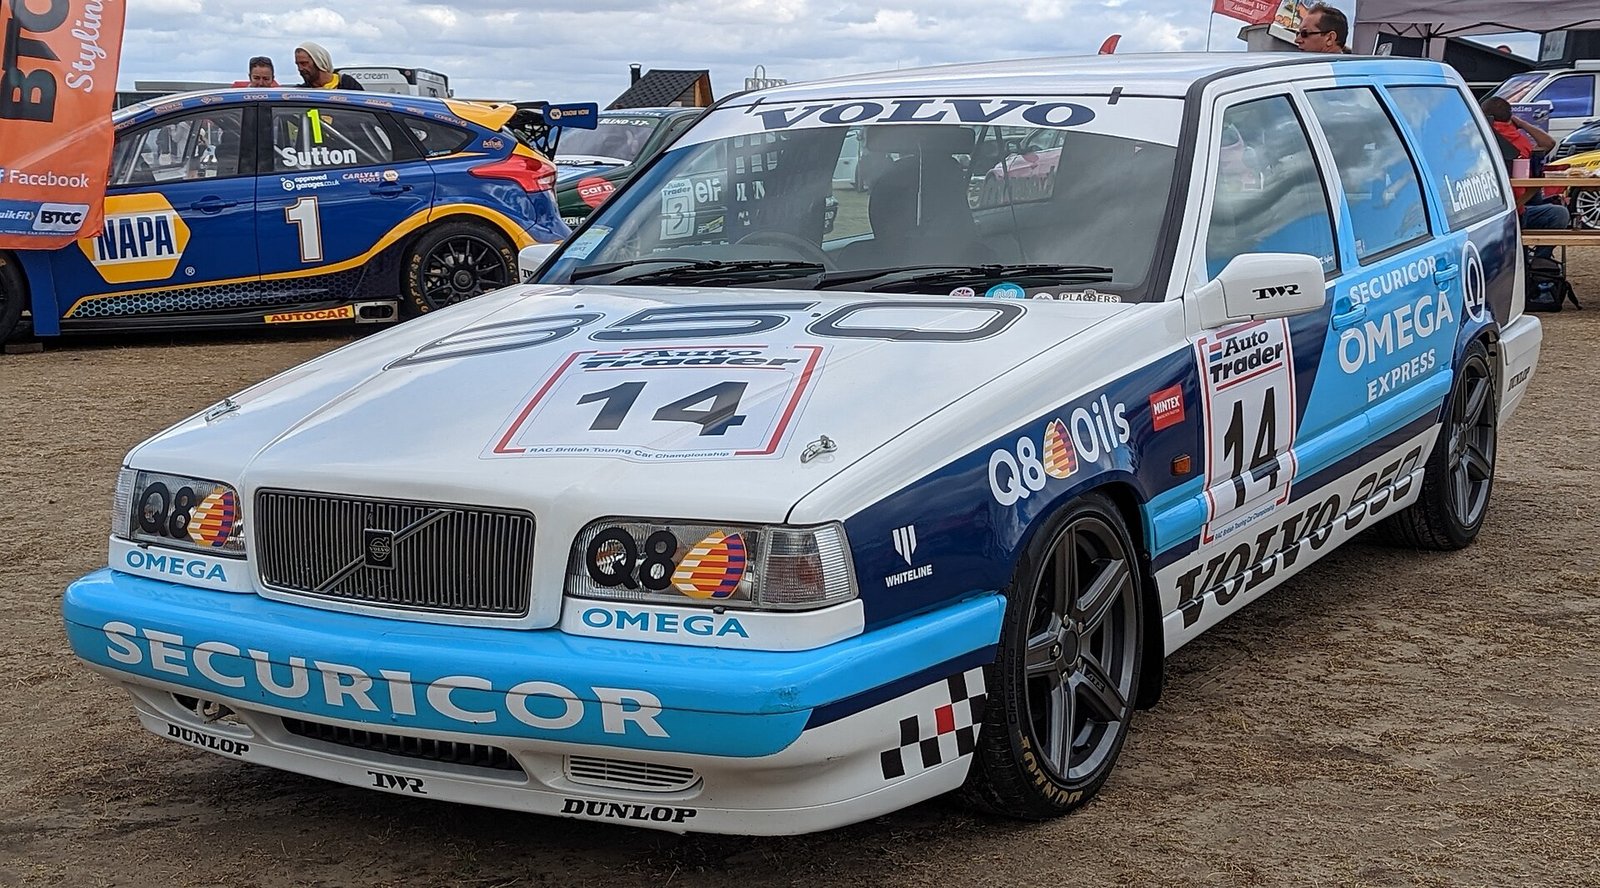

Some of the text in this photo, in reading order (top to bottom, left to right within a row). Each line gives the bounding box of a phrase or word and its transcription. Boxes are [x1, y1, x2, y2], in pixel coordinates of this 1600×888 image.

[65, 0, 113, 93] Stylin
[307, 108, 323, 144] 1
[754, 99, 1096, 131] VOLVO
[282, 146, 358, 167] Sutton
[9, 170, 90, 188] Facebook
[294, 173, 328, 182] approved
[295, 180, 340, 190] garages.co.uk
[342, 171, 380, 180] CARLYLE
[662, 186, 692, 196] Trader
[695, 177, 723, 203] elf
[1444, 172, 1500, 213] Lammers
[41, 210, 82, 225] BTCC
[285, 196, 324, 262] 1
[100, 215, 175, 260] NAPA
[1252, 284, 1302, 300] TWR
[1349, 255, 1437, 306] SECURICOR
[270, 307, 350, 322] AUTOCAR
[381, 301, 1028, 371] 850
[1223, 328, 1269, 358] Auto
[1338, 290, 1454, 374] OMEGA
[578, 356, 802, 370] Trader
[629, 349, 763, 359] Auto
[1209, 341, 1284, 384] Trader
[1366, 348, 1436, 403] EXPRESS
[576, 380, 749, 437] 14
[1153, 395, 1180, 416] MINTEX
[593, 447, 632, 456] Touring
[634, 449, 653, 459] Car
[655, 451, 730, 460] Championship
[988, 393, 1131, 506] Q8 Oils
[1223, 386, 1281, 510] 14
[138, 482, 197, 539] Q8
[1175, 445, 1422, 629] VOLVO 850
[126, 549, 228, 583] OMEGA
[586, 527, 678, 591] Q8
[885, 564, 933, 588] WHITELINE
[582, 608, 750, 638] OMEGA
[102, 621, 671, 738] SECURICOR
[167, 723, 250, 756] DUNLOP
[367, 770, 428, 794] TWR
[560, 797, 698, 824] DUNLOP
